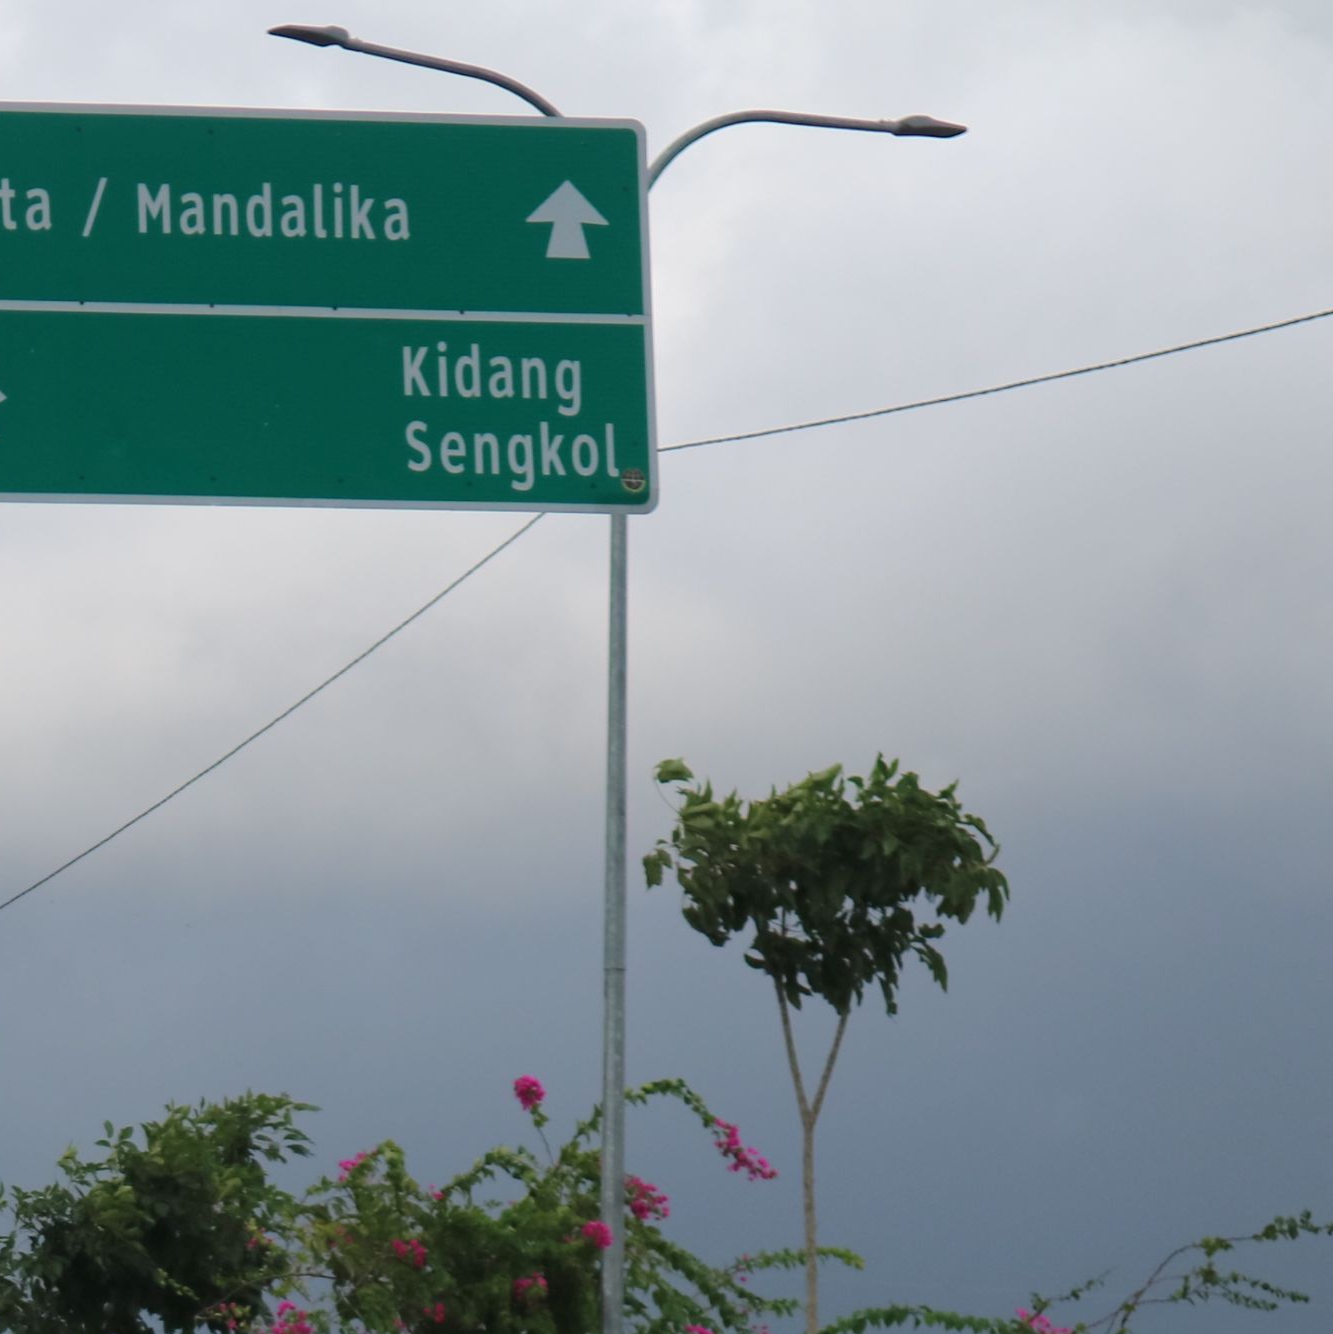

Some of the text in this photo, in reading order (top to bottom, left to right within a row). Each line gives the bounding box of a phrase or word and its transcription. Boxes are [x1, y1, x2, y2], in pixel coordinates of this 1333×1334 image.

[82, 177, 108, 237] /
[137, 182, 411, 241] Mandalika
[402, 341, 582, 417] Kidang
[404, 420, 620, 491] Sengkol
